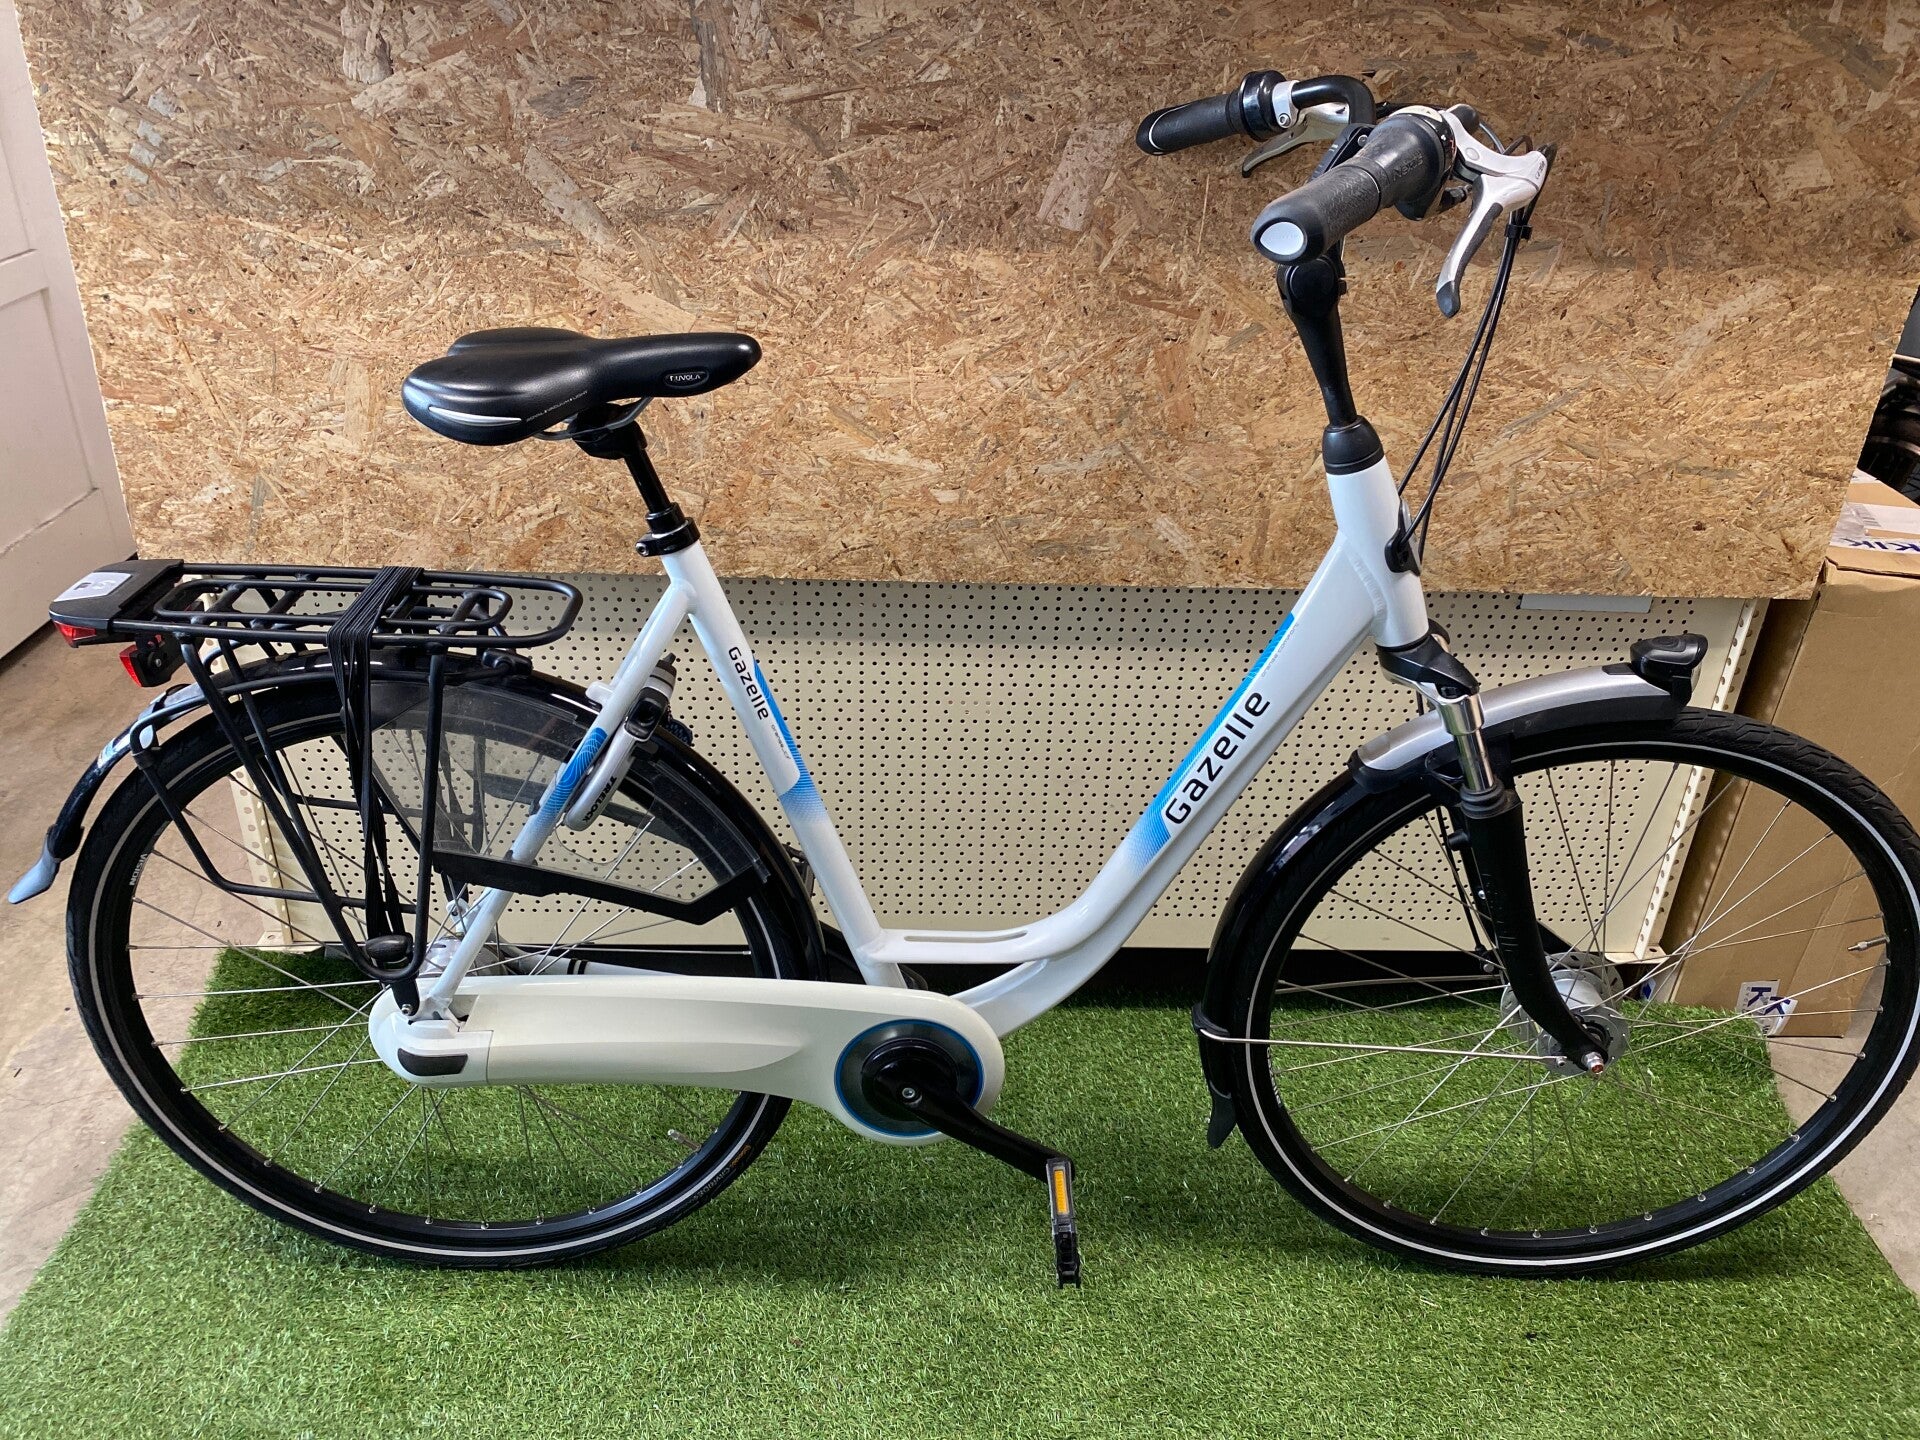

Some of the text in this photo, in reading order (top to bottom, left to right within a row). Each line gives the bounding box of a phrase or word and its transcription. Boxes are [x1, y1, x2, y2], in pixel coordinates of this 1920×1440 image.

[728, 646, 769, 720] Gazelle
[1165, 692, 1271, 825] Gazelle
[582, 776, 618, 823] TRELOCK
